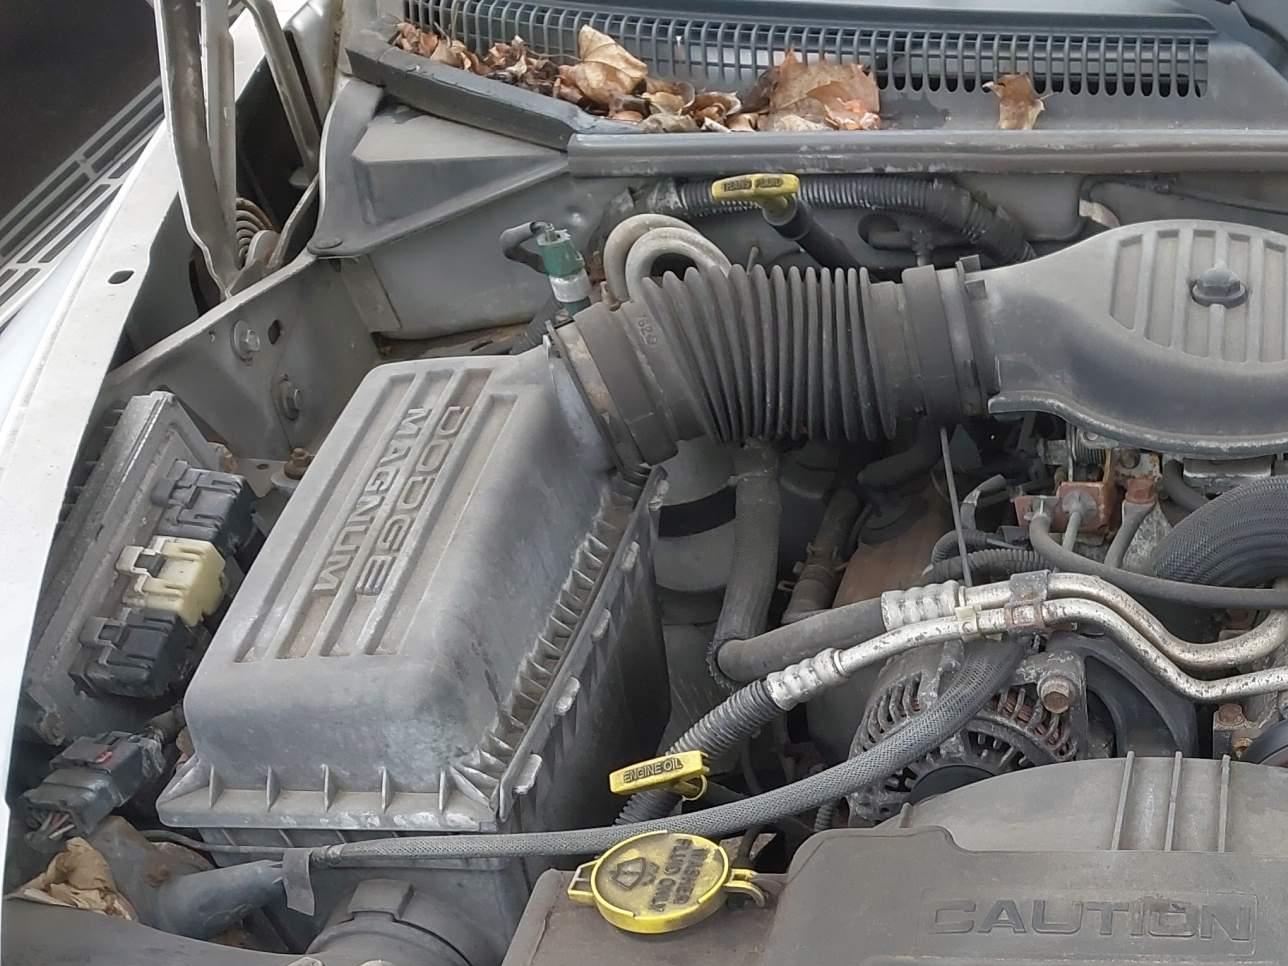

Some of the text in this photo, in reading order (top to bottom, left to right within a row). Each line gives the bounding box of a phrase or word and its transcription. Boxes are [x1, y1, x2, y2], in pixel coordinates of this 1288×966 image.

[312, 407, 433, 594] MAGNUM
[354, 406, 472, 595] DODGE
[623, 757, 684, 784] ENGINE OIL
[931, 898, 1251, 942] CAUTION
